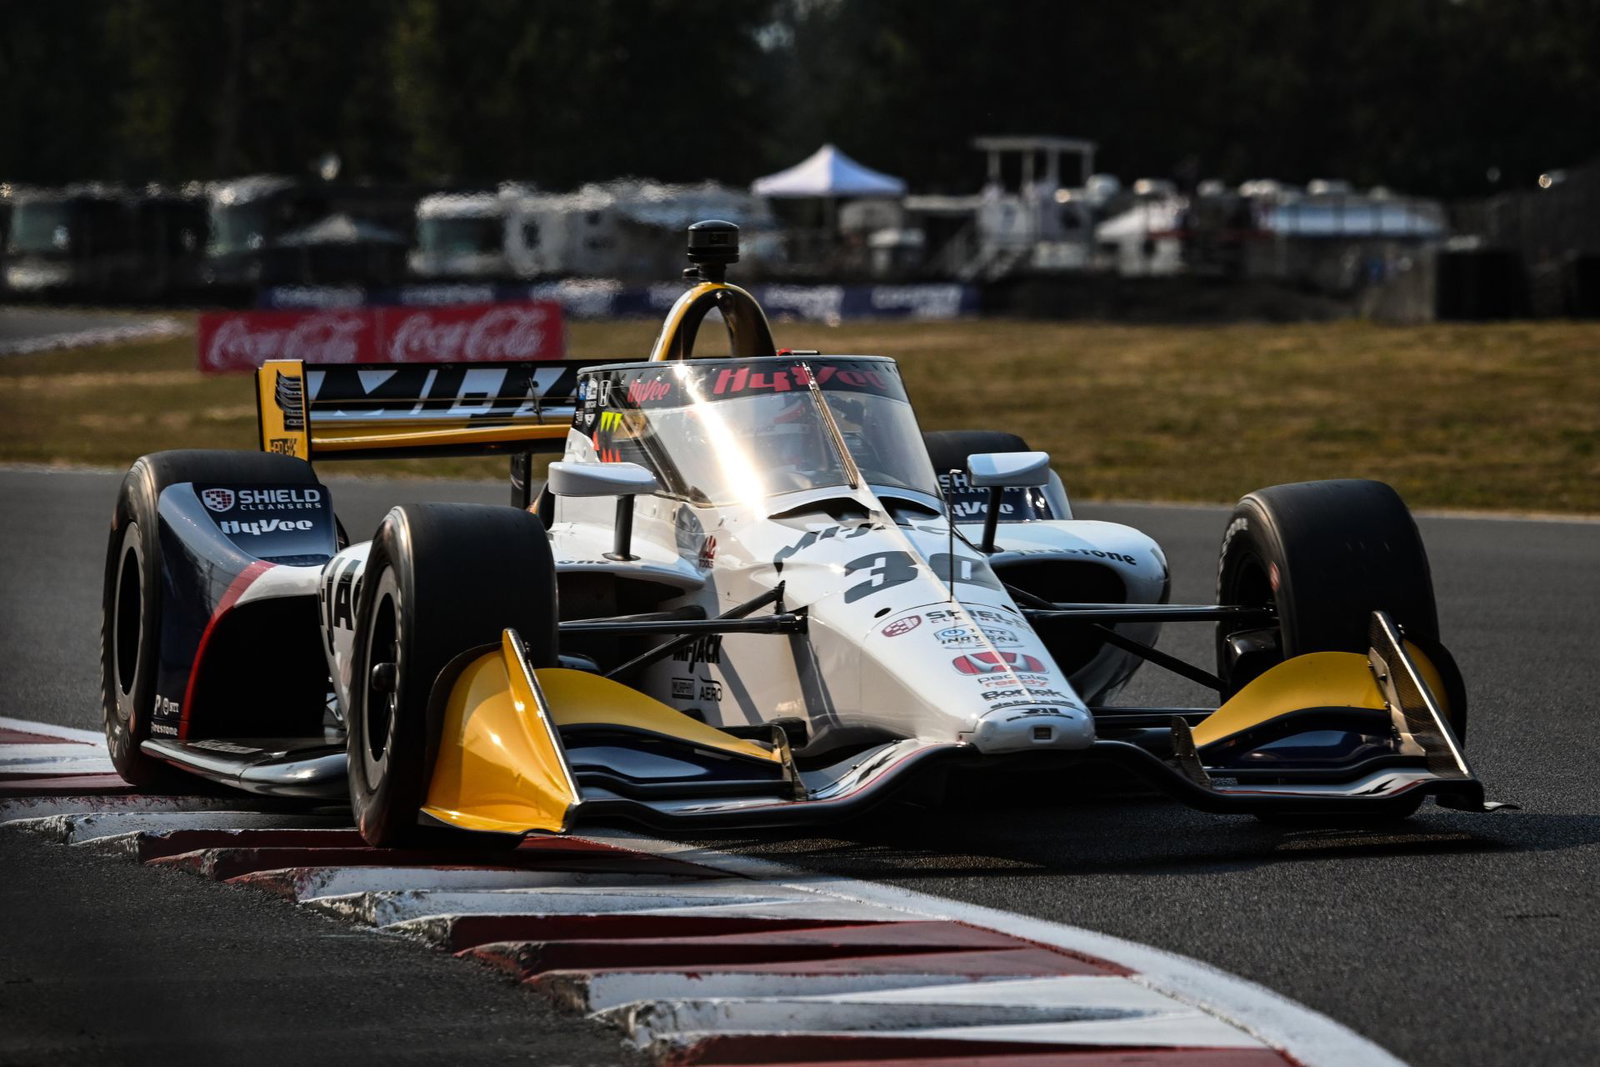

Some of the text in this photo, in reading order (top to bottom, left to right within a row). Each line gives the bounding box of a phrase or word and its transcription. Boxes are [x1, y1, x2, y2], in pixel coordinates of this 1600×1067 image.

[238, 488, 322, 504] SHIELD
[239, 502, 322, 511] CLEANSERS
[219, 518, 314, 536] HyVee
[843, 550, 1003, 604] 30
[699, 686, 722, 702] AERO
